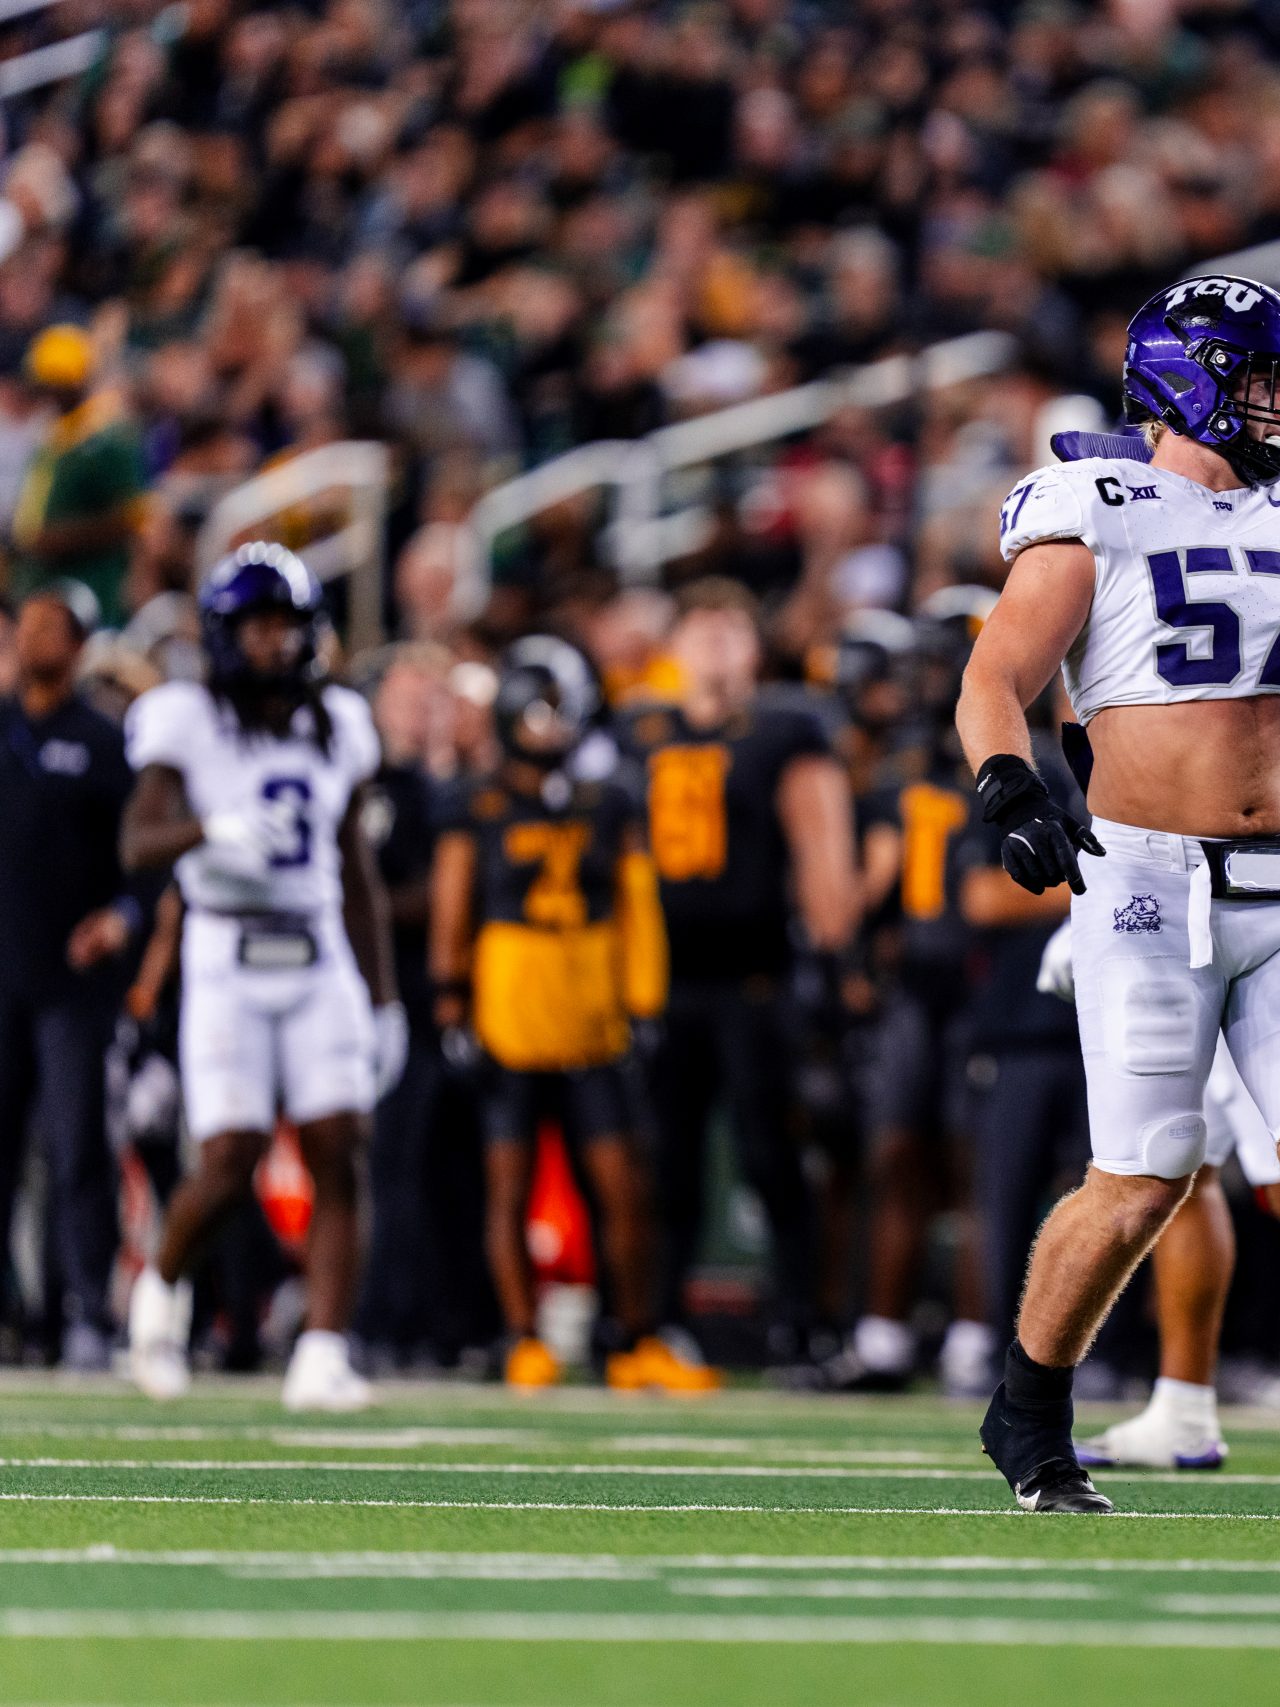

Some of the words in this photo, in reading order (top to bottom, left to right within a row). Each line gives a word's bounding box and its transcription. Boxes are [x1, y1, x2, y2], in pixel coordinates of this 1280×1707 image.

[1165, 279, 1264, 312] TCU
[1095, 477, 1124, 506] C
[1126, 485, 1161, 501] XII
[1212, 501, 1233, 512] TCU
